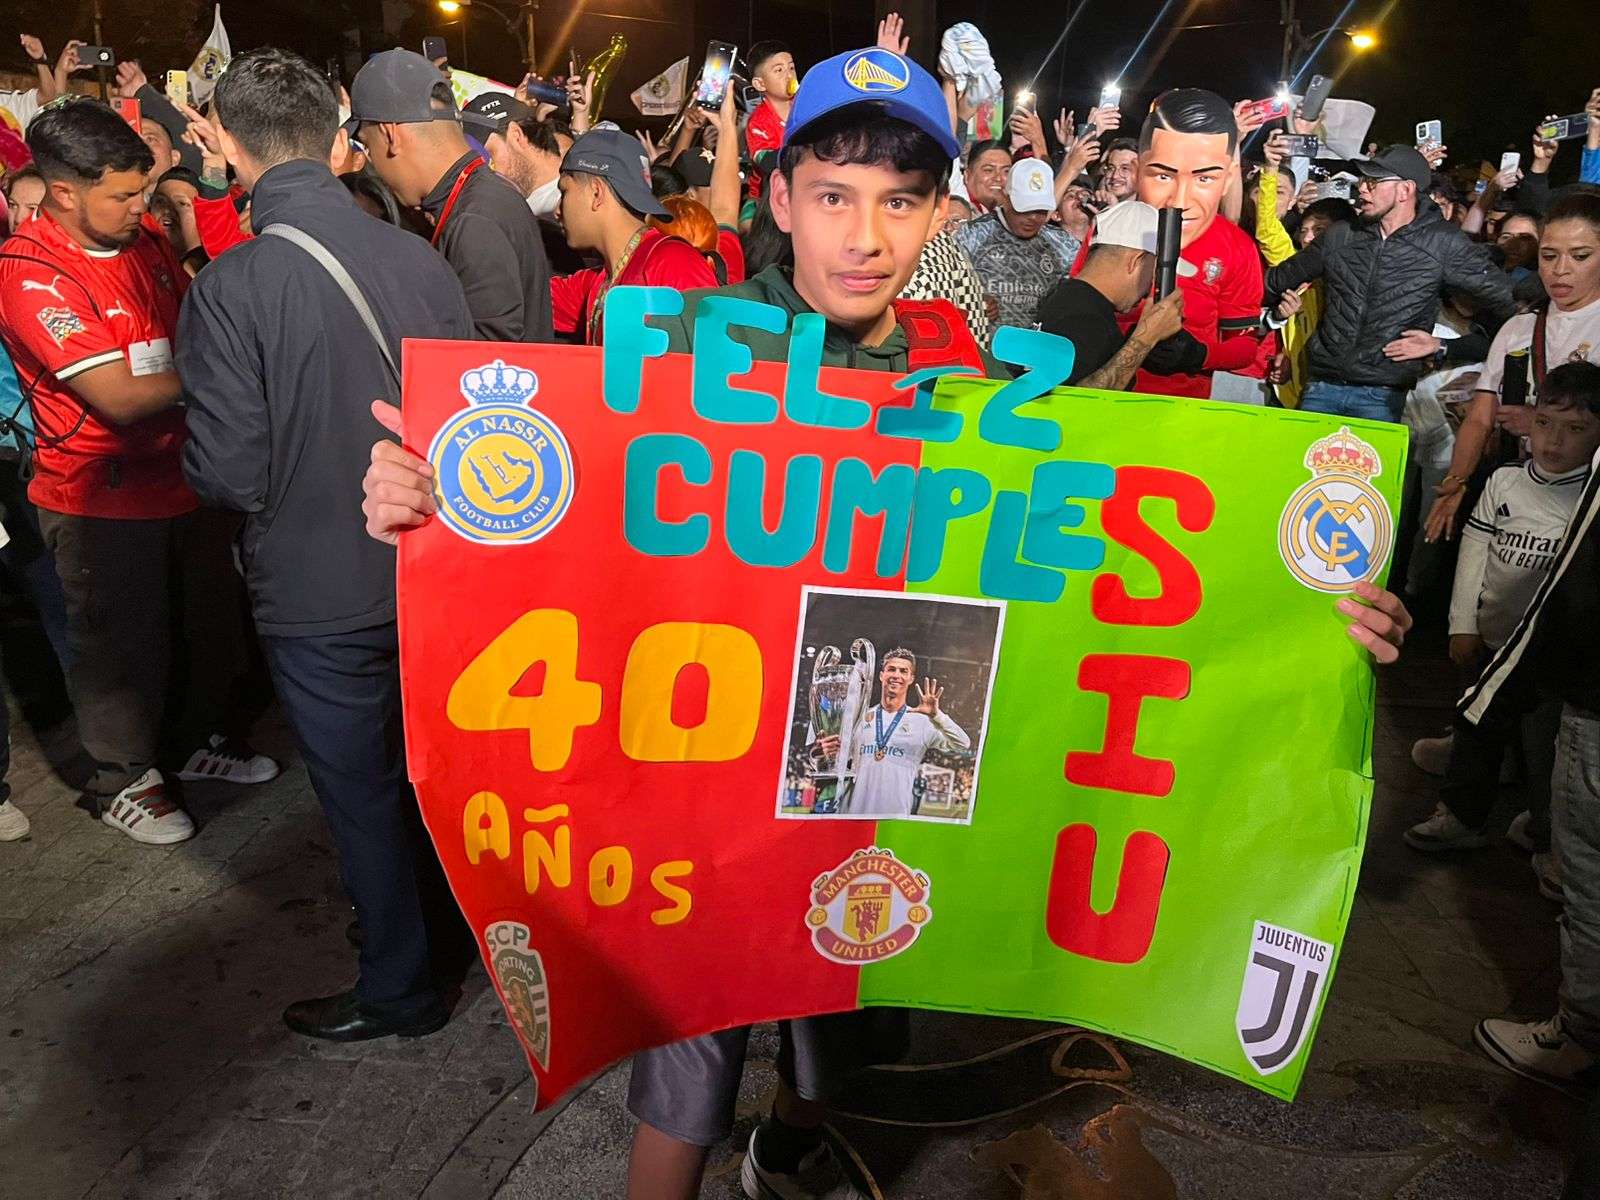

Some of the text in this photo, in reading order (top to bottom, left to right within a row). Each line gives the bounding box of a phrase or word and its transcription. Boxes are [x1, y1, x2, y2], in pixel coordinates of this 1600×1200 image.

[602, 285, 1077, 452] FELIZ
[454, 416, 549, 453] AL NASSR
[454, 495, 550, 529] FOOTBALL CLUB
[1497, 529, 1563, 554] Emirat
[446, 608, 765, 772] 40
[462, 790, 694, 926] AÑOS
[822, 859, 918, 899] MANCHESTER
[486, 924, 528, 953] SCP
[831, 939, 898, 958] UNITED
[1256, 925, 1328, 963] JUVENTUS
